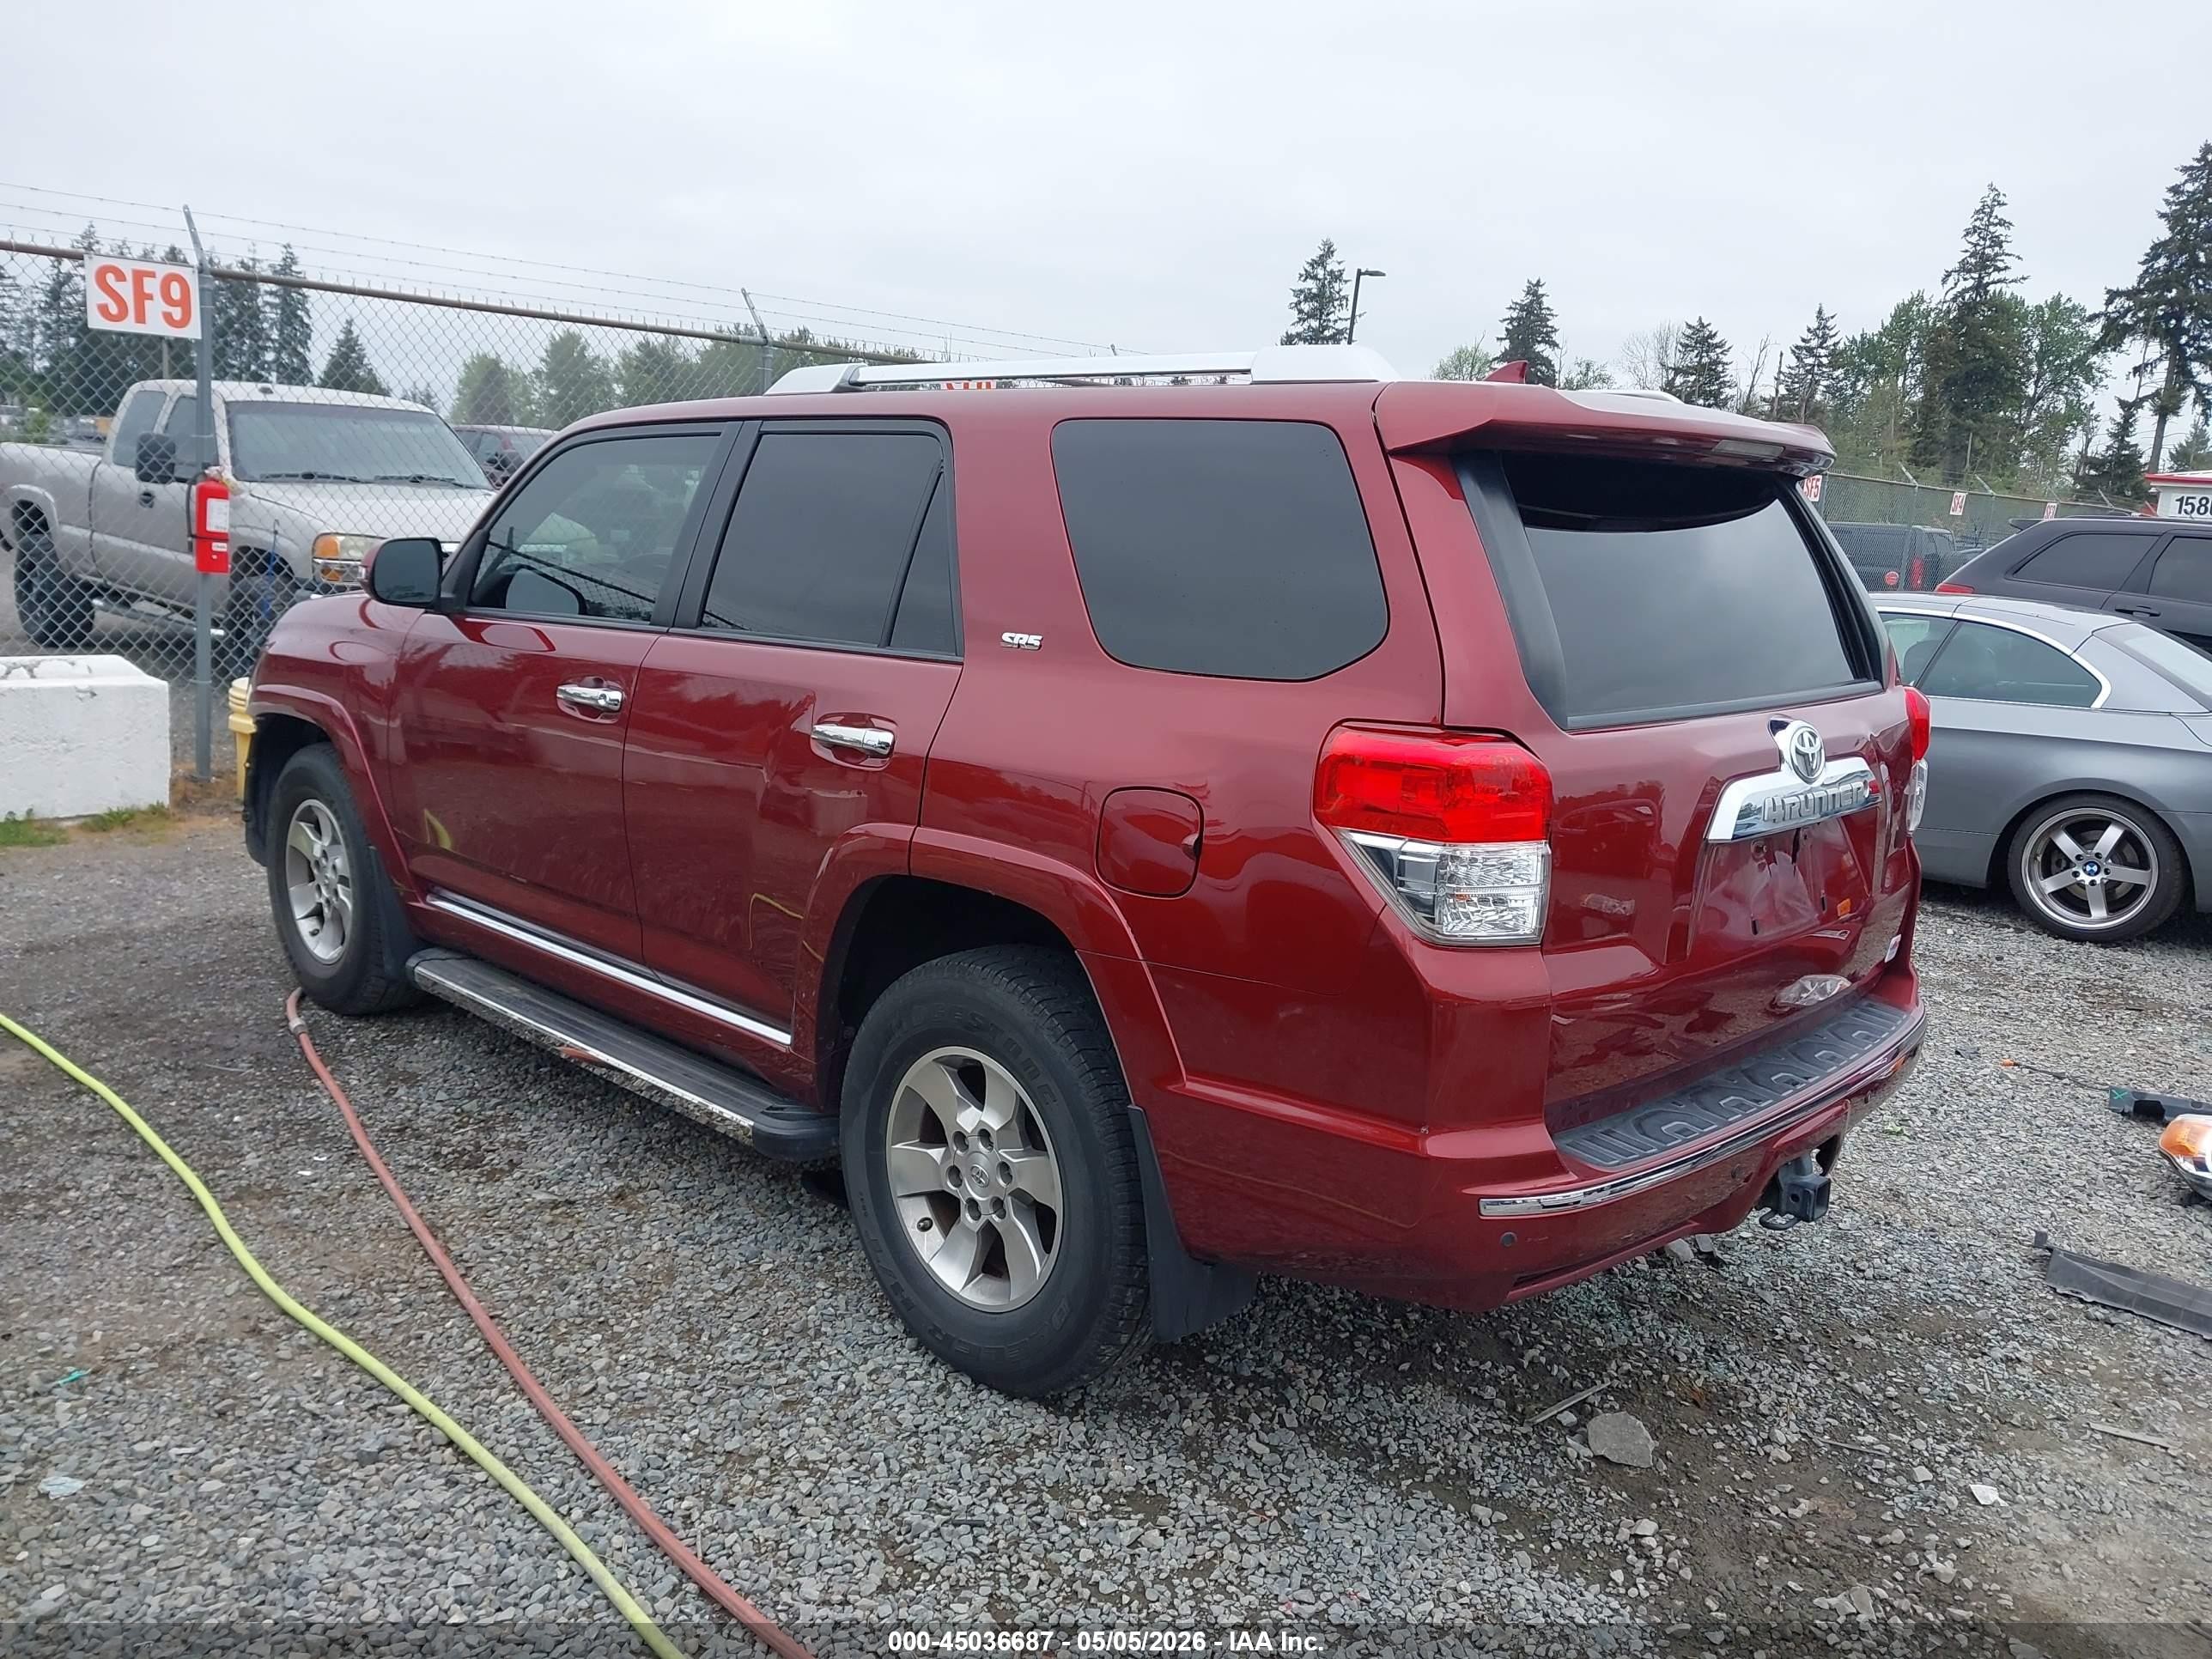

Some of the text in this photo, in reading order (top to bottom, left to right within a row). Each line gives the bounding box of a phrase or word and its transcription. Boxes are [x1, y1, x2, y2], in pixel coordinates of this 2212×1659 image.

[94, 264, 192, 329] SF9
[1804, 477, 1820, 498] SF5
[2175, 495, 2212, 516] 158
[1000, 632, 1043, 650] SR5
